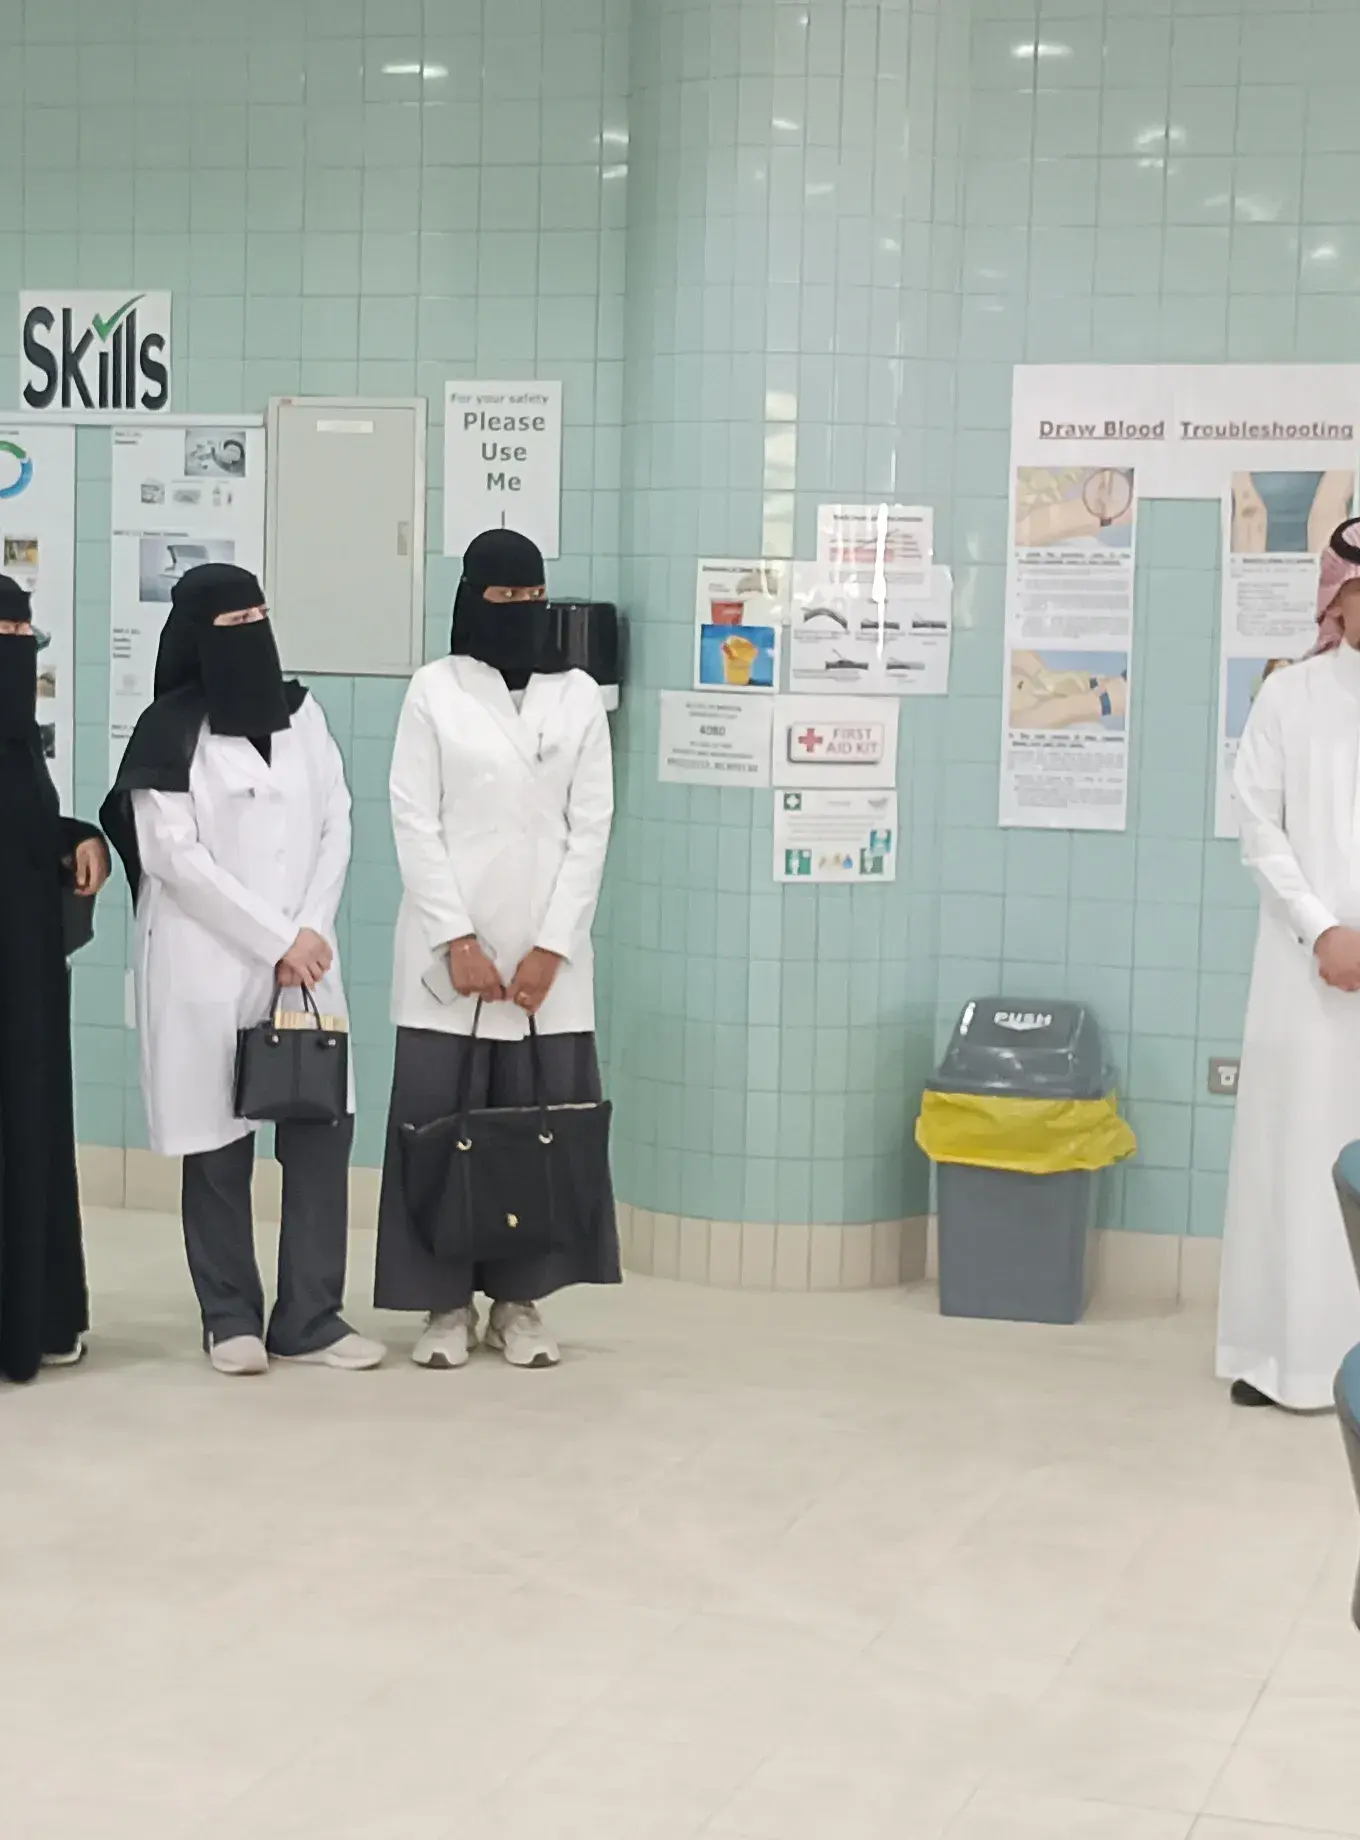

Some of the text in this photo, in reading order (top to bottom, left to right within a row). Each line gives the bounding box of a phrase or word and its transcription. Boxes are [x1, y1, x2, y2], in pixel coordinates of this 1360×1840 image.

[23, 305, 168, 410] Skills
[450, 393, 471, 405] For
[476, 394, 503, 407] your
[462, 411, 546, 432] Please
[1040, 420, 1354, 441] Draw Blood Troubleshooting
[481, 442, 527, 462] Use
[486, 472, 522, 492] Me
[832, 728, 872, 741] FIRST
[826, 742, 880, 756] AID KIT
[993, 1010, 1052, 1027] PUSH
